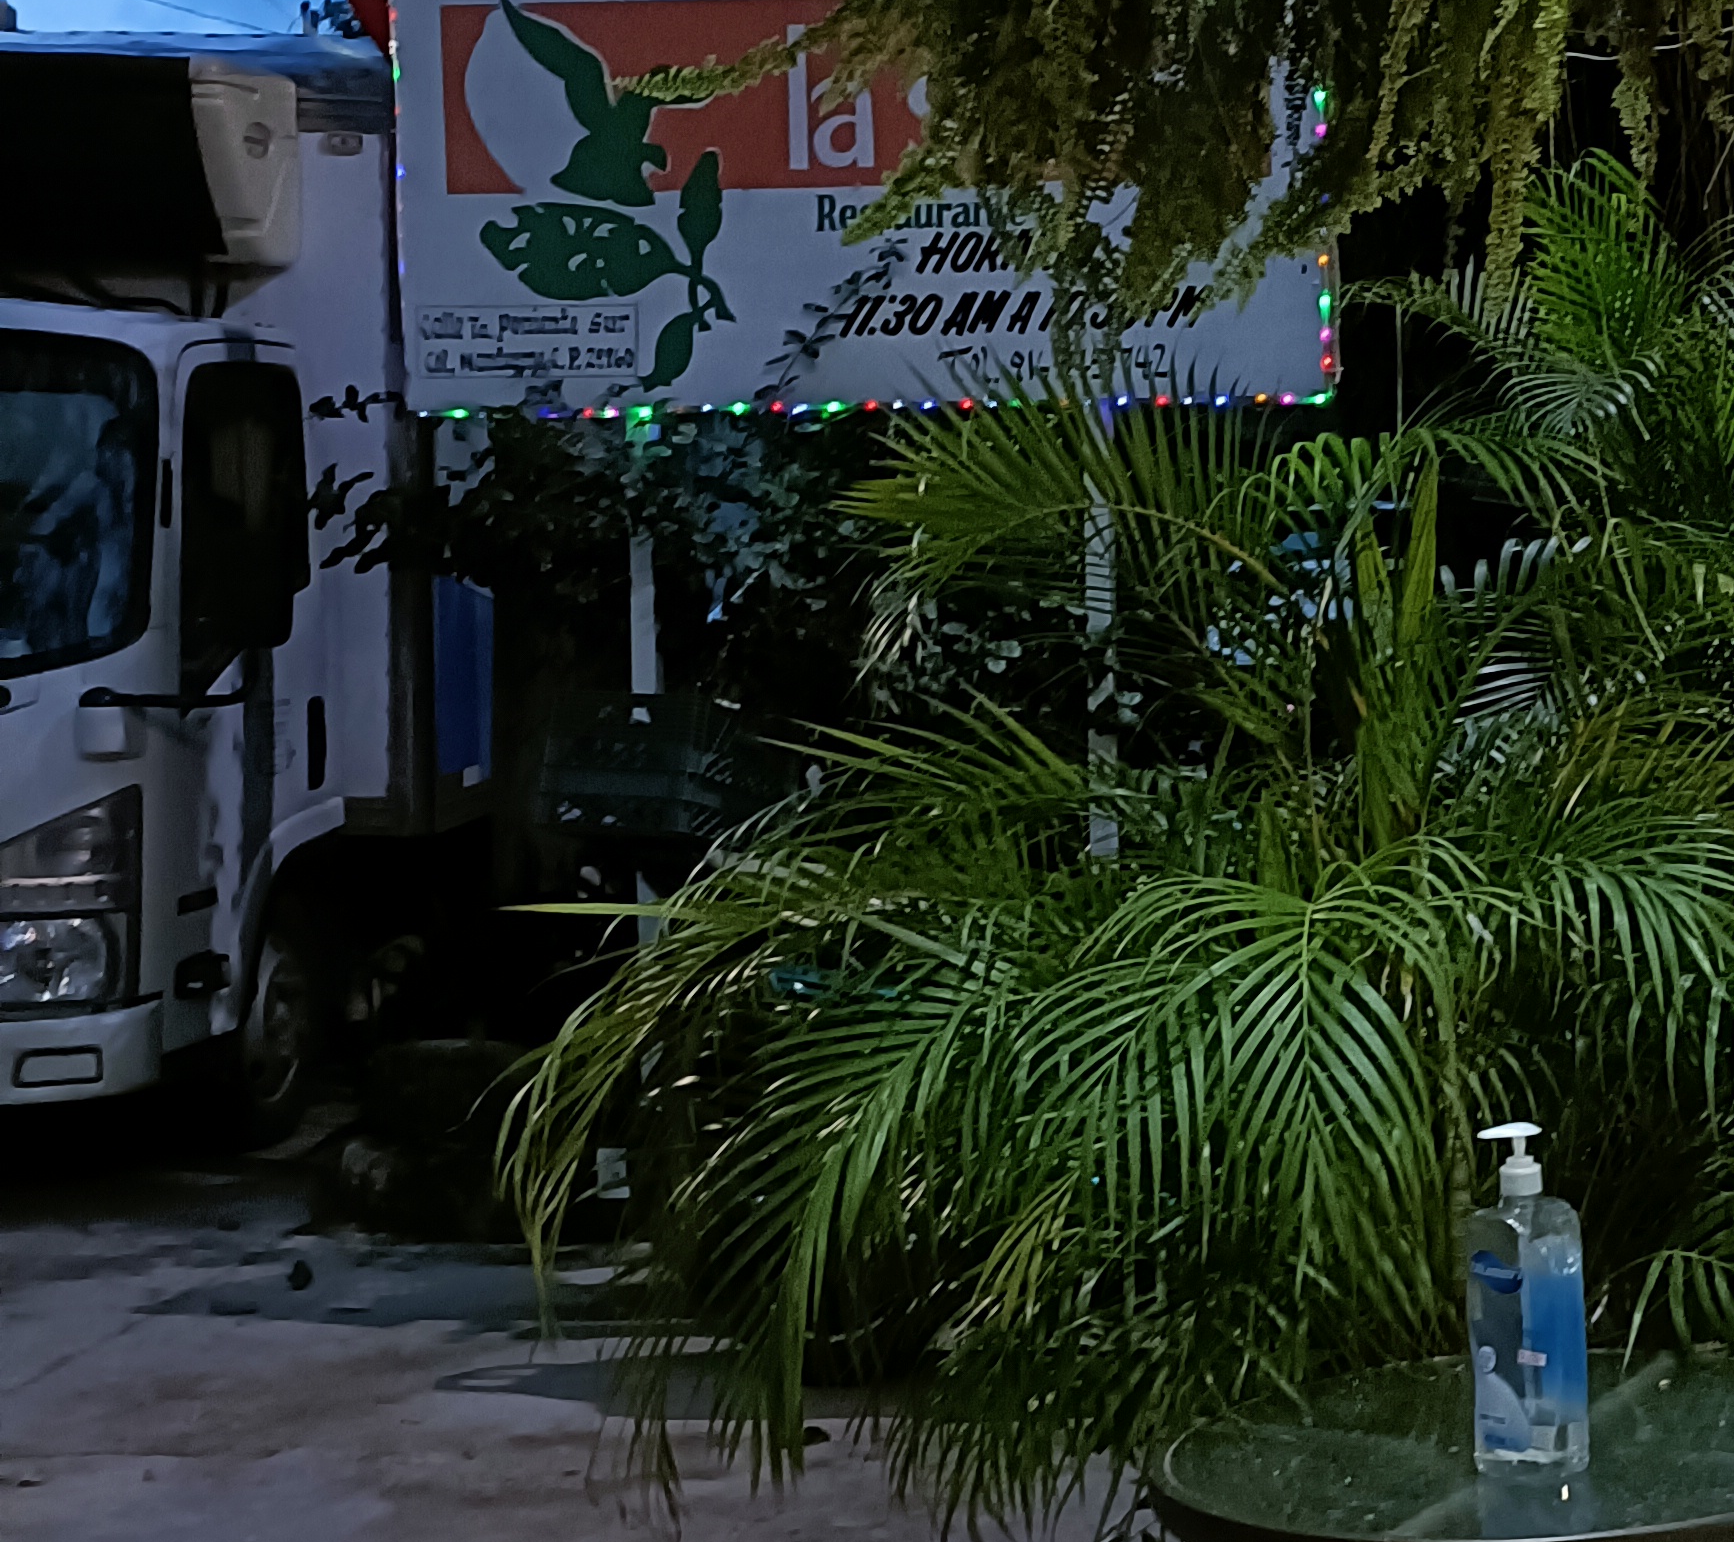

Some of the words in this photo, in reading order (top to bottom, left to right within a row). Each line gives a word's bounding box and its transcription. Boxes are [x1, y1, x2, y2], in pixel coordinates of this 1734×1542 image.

[786, 24, 876, 171] la
[839, 293, 944, 338] 11:30
[940, 289, 1012, 337] AM
[1006, 290, 1042, 335] A
